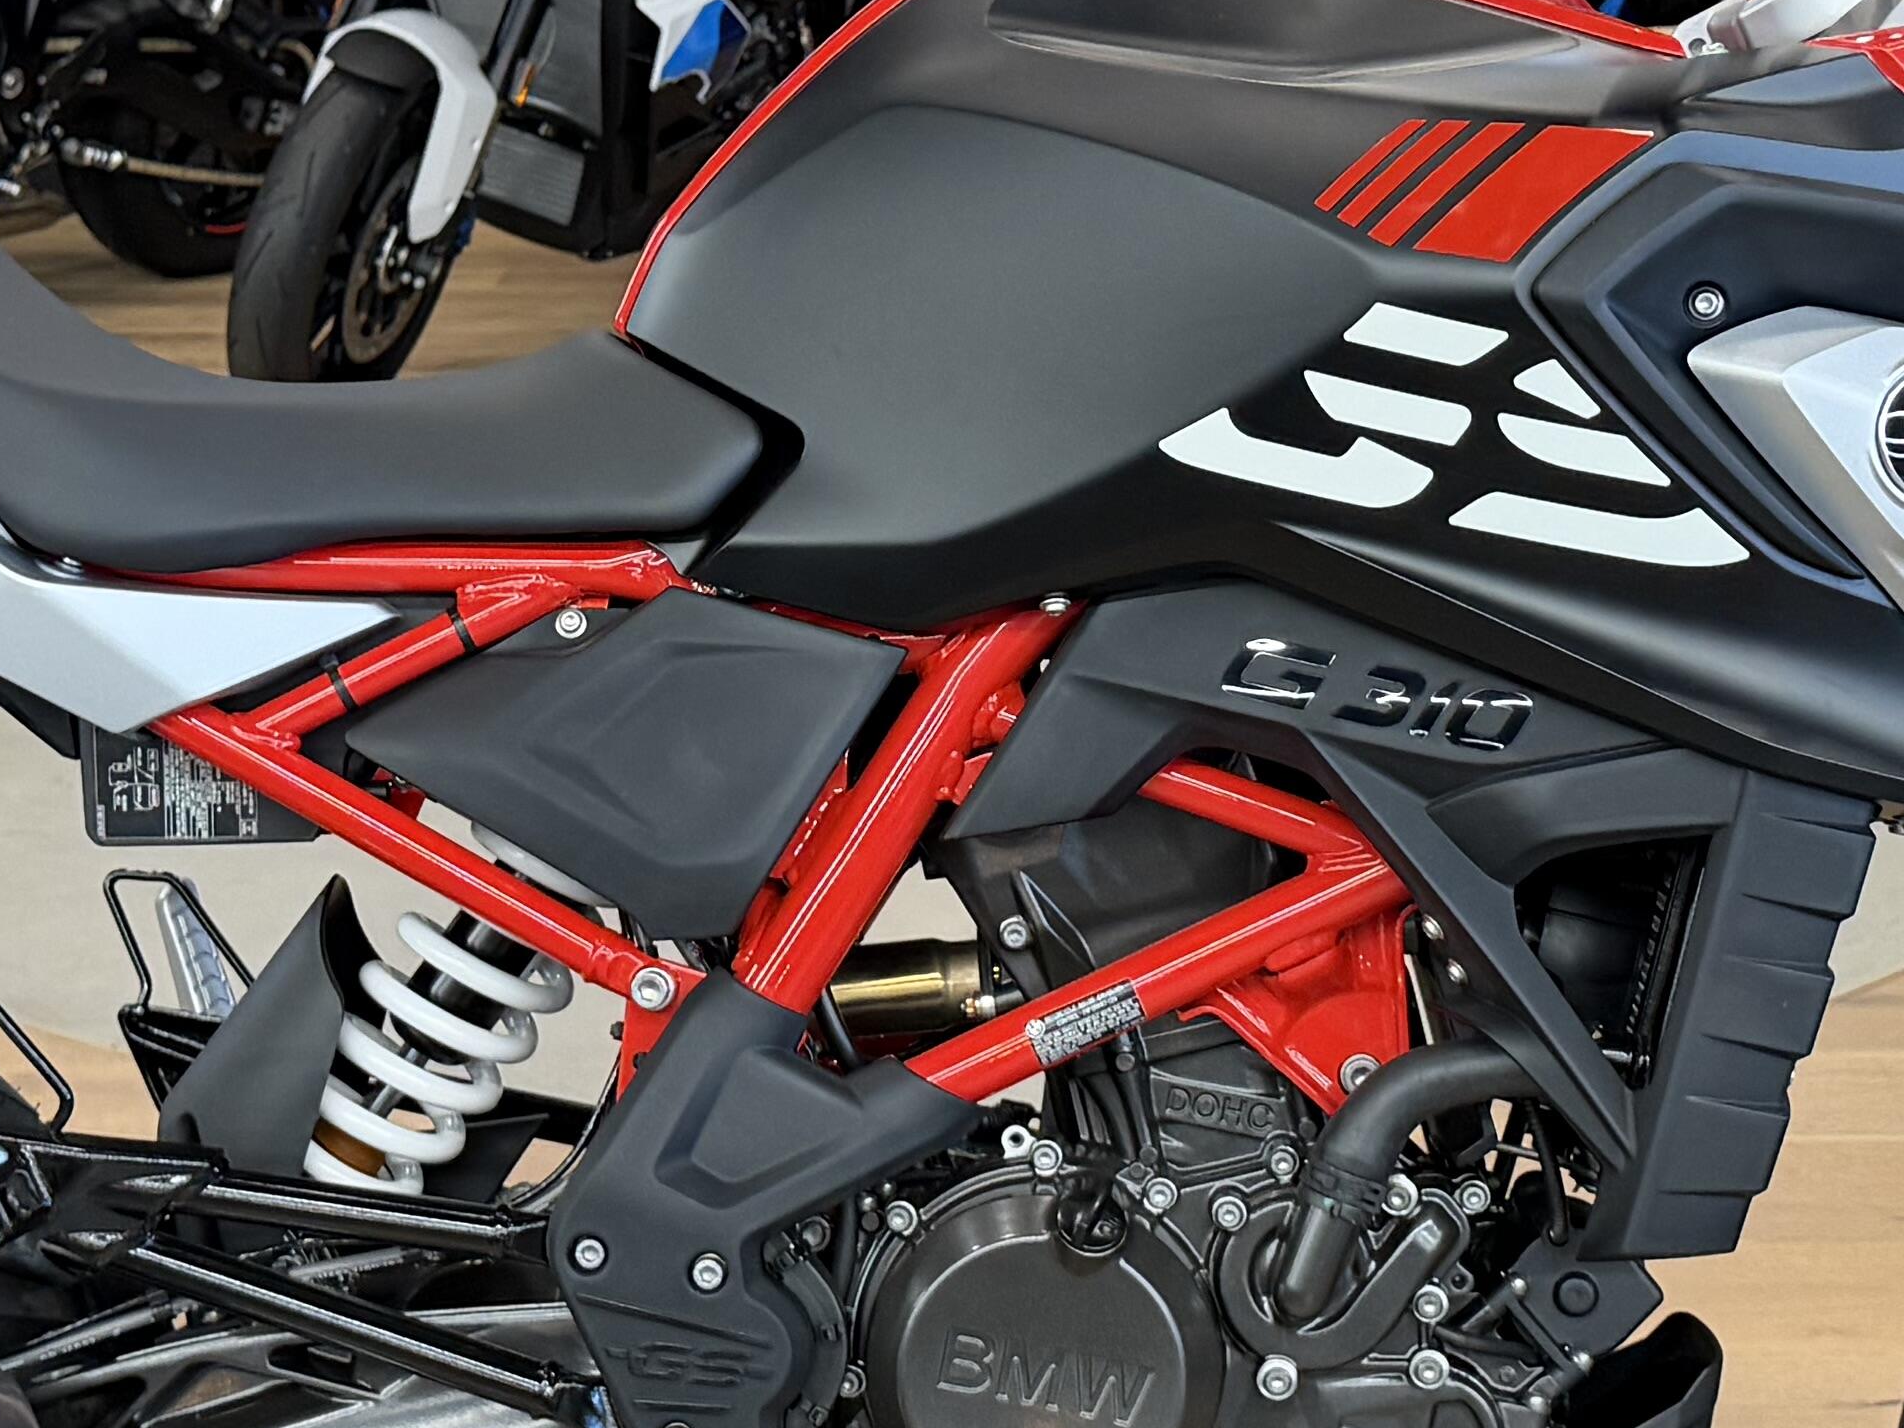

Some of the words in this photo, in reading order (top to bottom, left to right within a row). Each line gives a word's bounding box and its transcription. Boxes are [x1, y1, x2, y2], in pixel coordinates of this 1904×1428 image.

[1220, 636, 1338, 711] G
[1331, 664, 1535, 752] 310
[1165, 1085, 1277, 1134] DOHC
